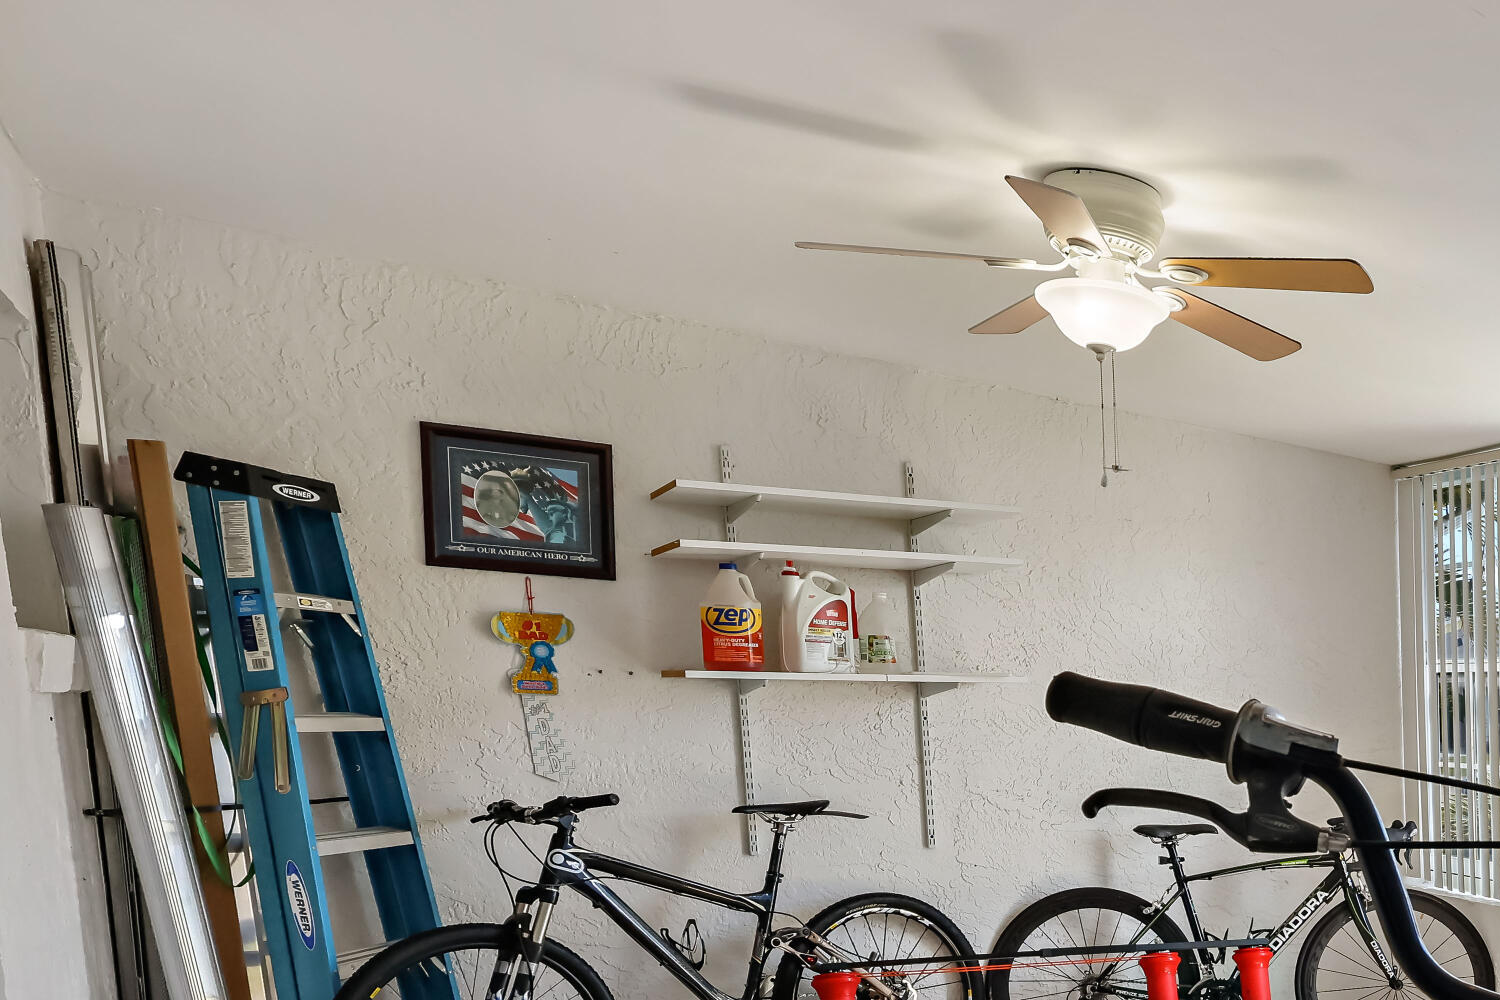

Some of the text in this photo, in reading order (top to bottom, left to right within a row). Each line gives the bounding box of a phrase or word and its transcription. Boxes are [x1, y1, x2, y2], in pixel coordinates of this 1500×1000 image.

[282, 487, 311, 498] WERNER
[476, 546, 568, 560] OUR AMERICAN HERO
[813, 618, 828, 626] HOME
[537, 718, 561, 773] DAD
[292, 880, 311, 932] WERNER
[1269, 890, 1329, 952] DIADORA
[1370, 940, 1395, 978] DIADORA
